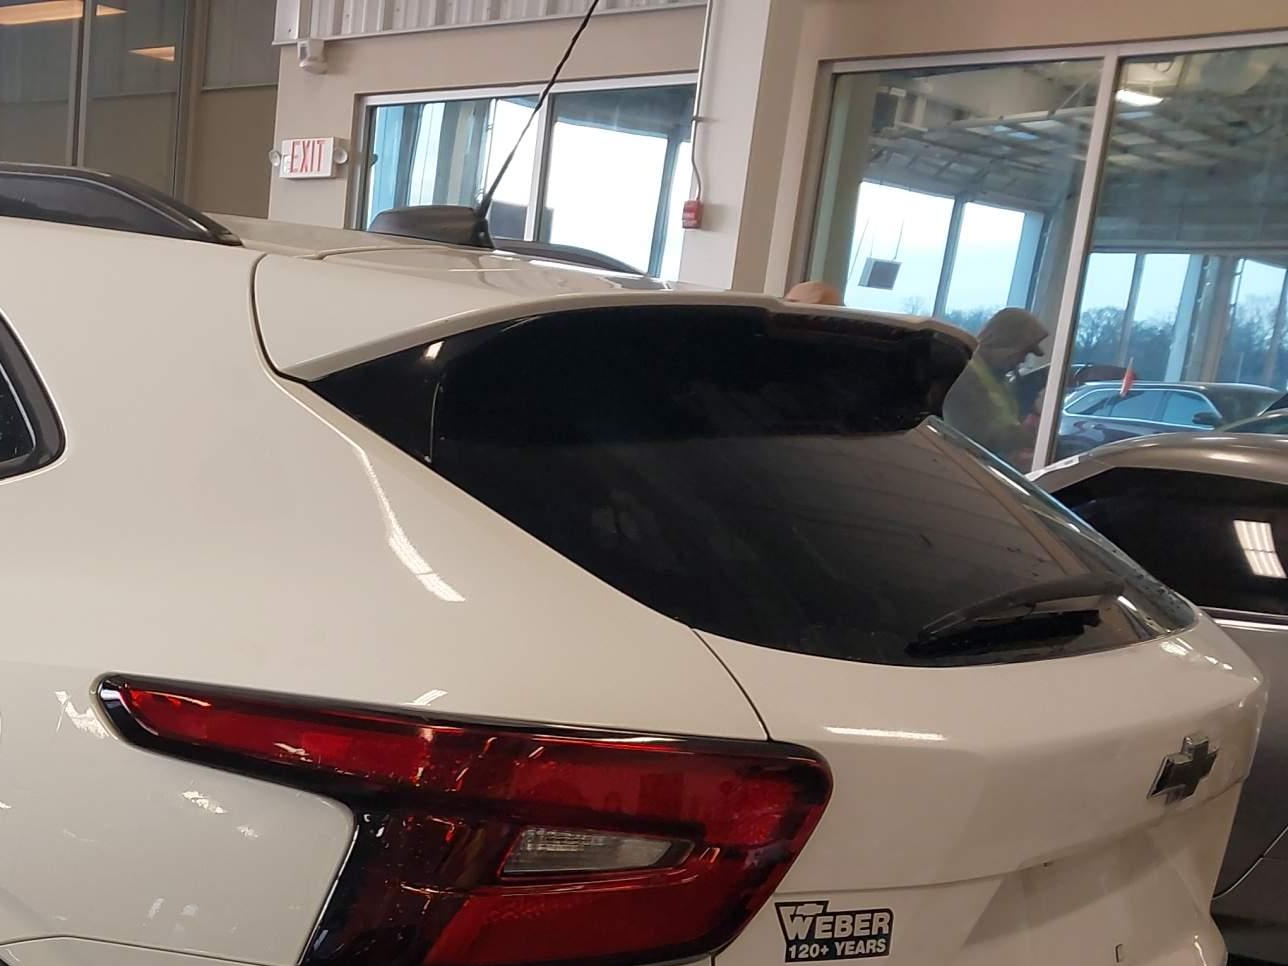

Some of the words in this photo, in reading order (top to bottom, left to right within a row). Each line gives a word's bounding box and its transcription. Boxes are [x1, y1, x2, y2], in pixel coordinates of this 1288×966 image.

[289, 139, 326, 173] EXIT
[778, 905, 891, 941] WEBER
[788, 942, 830, 959] 120+
[833, 938, 887, 956] YEARS
